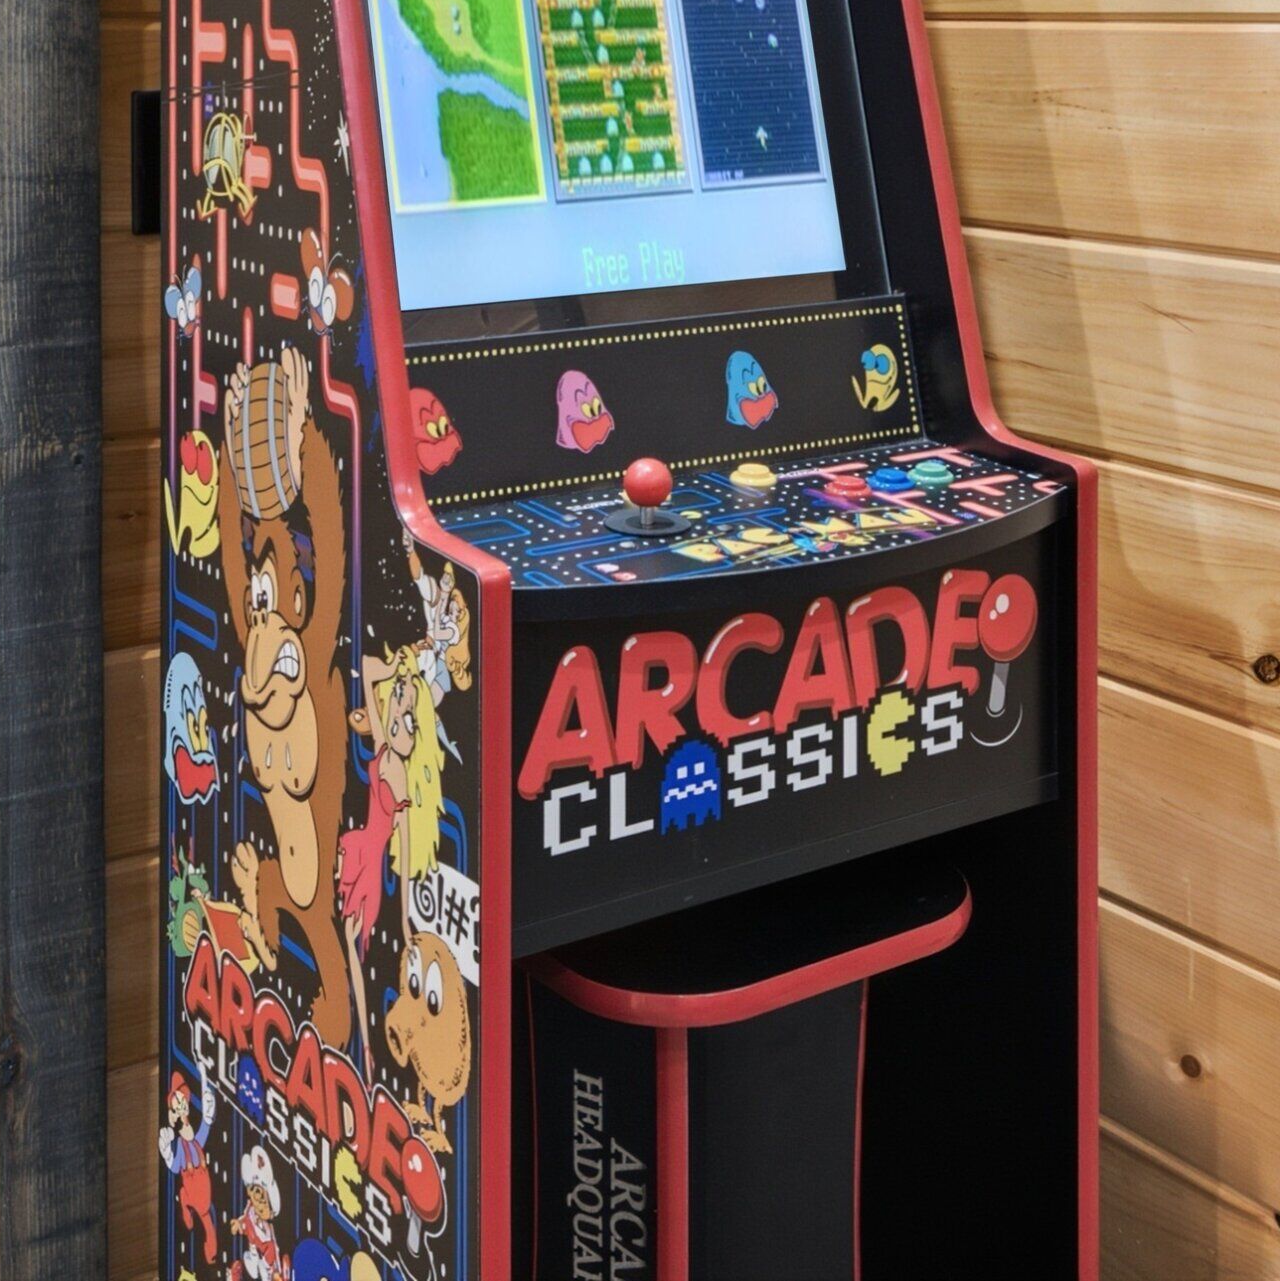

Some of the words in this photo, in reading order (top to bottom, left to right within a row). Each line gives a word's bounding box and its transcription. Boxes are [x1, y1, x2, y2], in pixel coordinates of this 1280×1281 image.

[582, 246, 630, 288] Free
[639, 241, 686, 284] Play
[519, 569, 992, 800] ARCADE
[543, 689, 963, 856] CLASSICS
[185, 937, 416, 1216] ARCADE
[610, 1137, 647, 1281] ARCA
